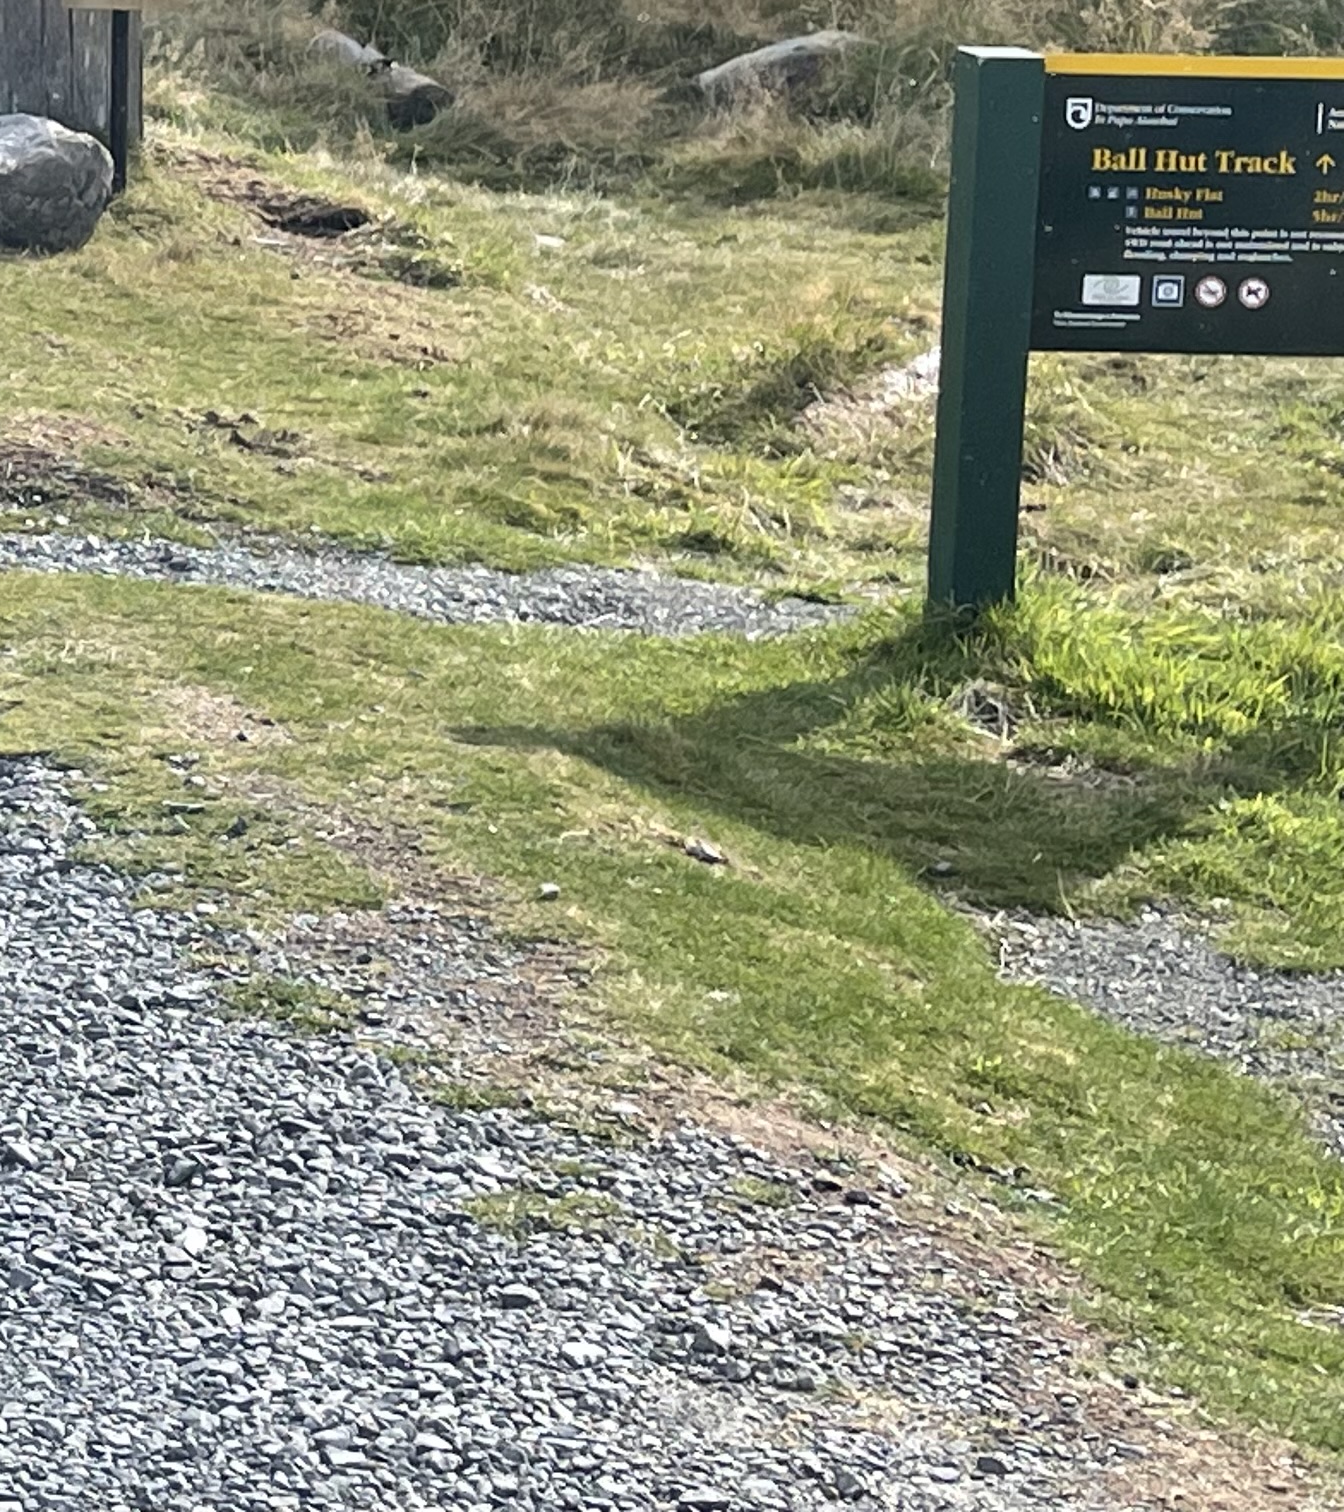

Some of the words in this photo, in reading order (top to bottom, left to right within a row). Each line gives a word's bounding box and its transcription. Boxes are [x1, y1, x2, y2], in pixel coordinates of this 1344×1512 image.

[1095, 102, 1152, 115] Department
[1154, 103, 1166, 114] of
[1167, 103, 1232, 116] Conservation
[1091, 147, 1147, 172] Ball
[1154, 149, 1207, 172] Hut
[1215, 150, 1296, 175] Track
[1145, 187, 1192, 205] Husky
[1196, 188, 1223, 202] Flat
[1144, 206, 1173, 219] Ball
[1176, 207, 1203, 220] Hut
[1193, 227, 1229, 240] beyond
